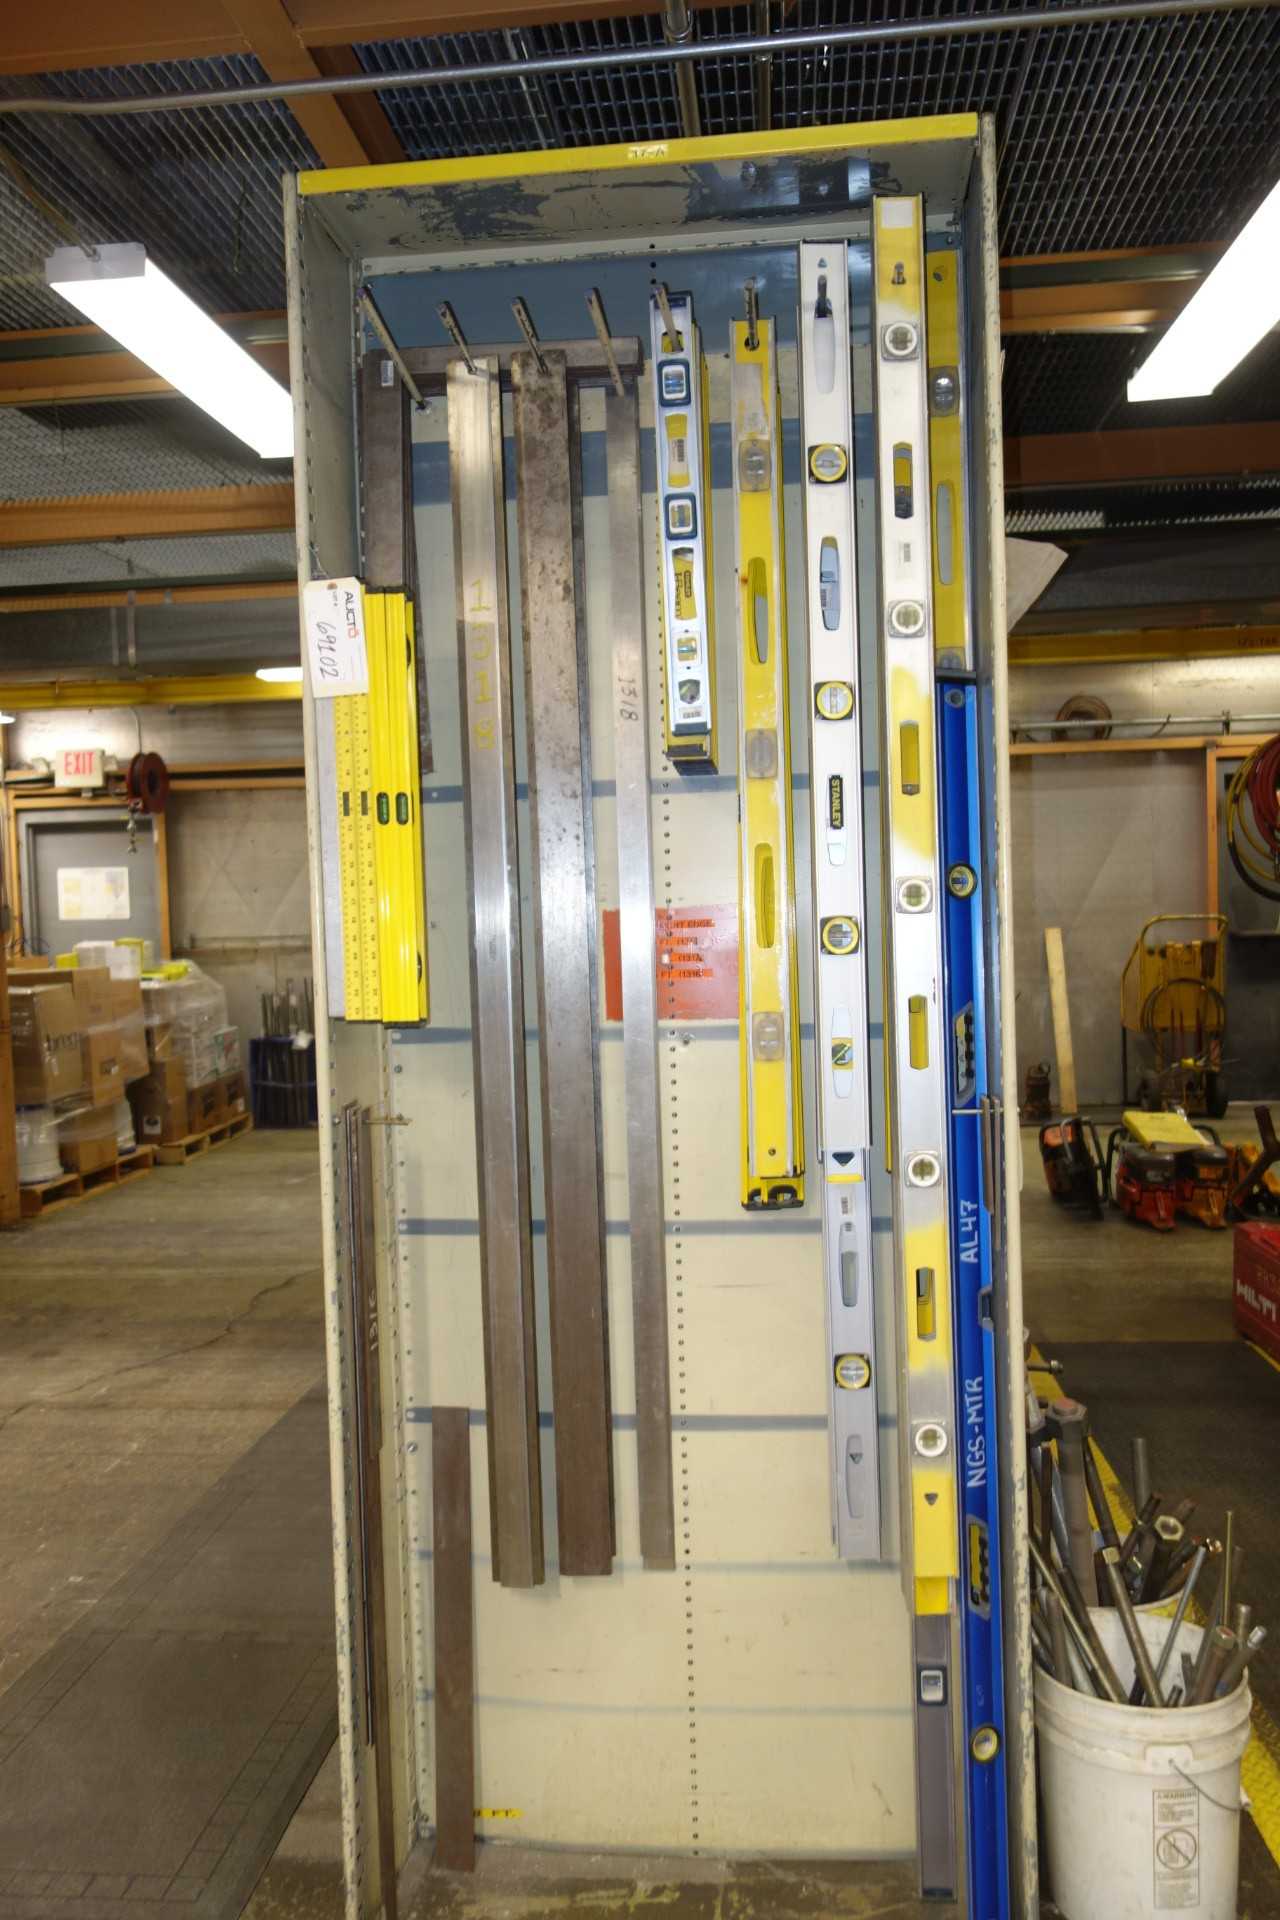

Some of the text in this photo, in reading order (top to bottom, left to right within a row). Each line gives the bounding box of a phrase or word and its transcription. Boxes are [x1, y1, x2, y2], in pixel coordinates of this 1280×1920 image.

[316, 621, 339, 679] 69102
[618, 676, 639, 722] 1318
[64, 751, 95, 775] EXIT
[831, 778, 842, 828] STANLEY
[960, 1199, 978, 1264] AL47
[965, 1376, 986, 1488] NGS-MTR
